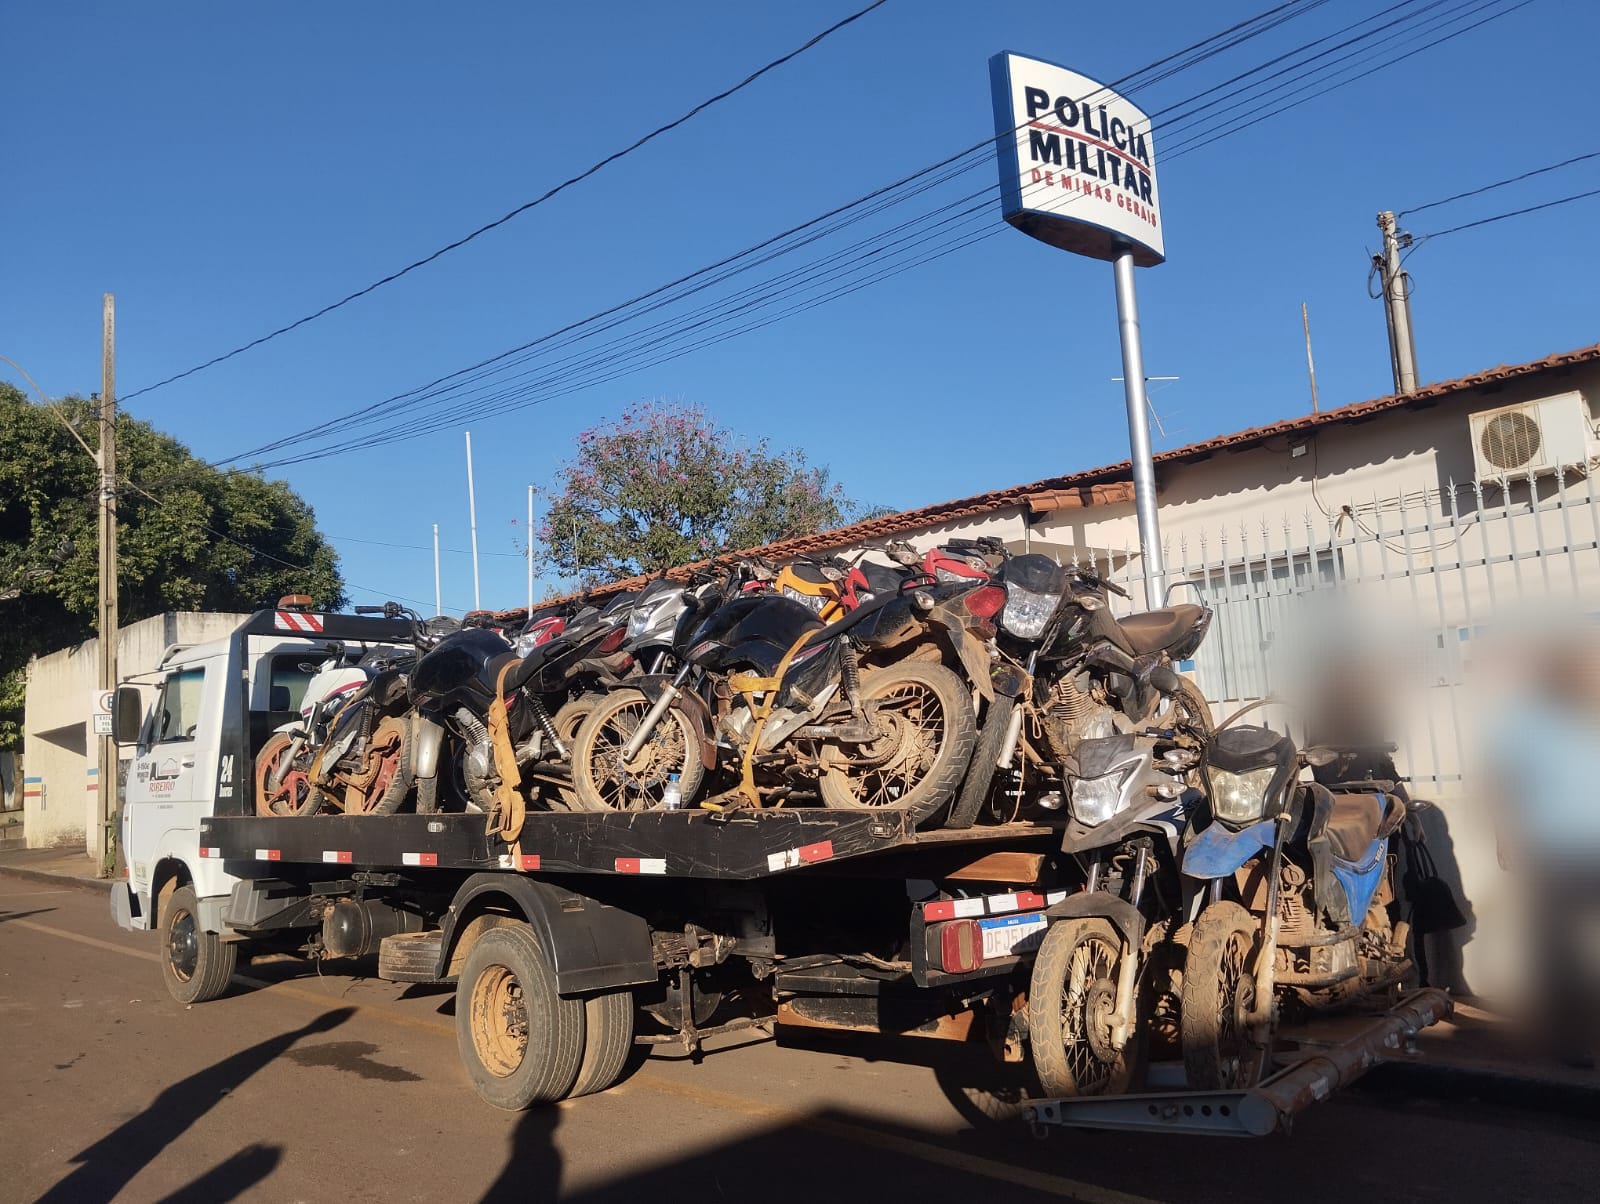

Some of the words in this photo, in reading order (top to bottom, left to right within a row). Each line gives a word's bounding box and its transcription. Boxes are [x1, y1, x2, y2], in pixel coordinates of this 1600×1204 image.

[1024, 86, 1150, 168] POLÍCIA
[1029, 129, 1153, 207] MILITAR
[1031, 168, 1054, 186] DE
[1061, 174, 1112, 203] MINAS
[1117, 193, 1157, 227] GERAIS
[220, 754, 234, 783] 24
